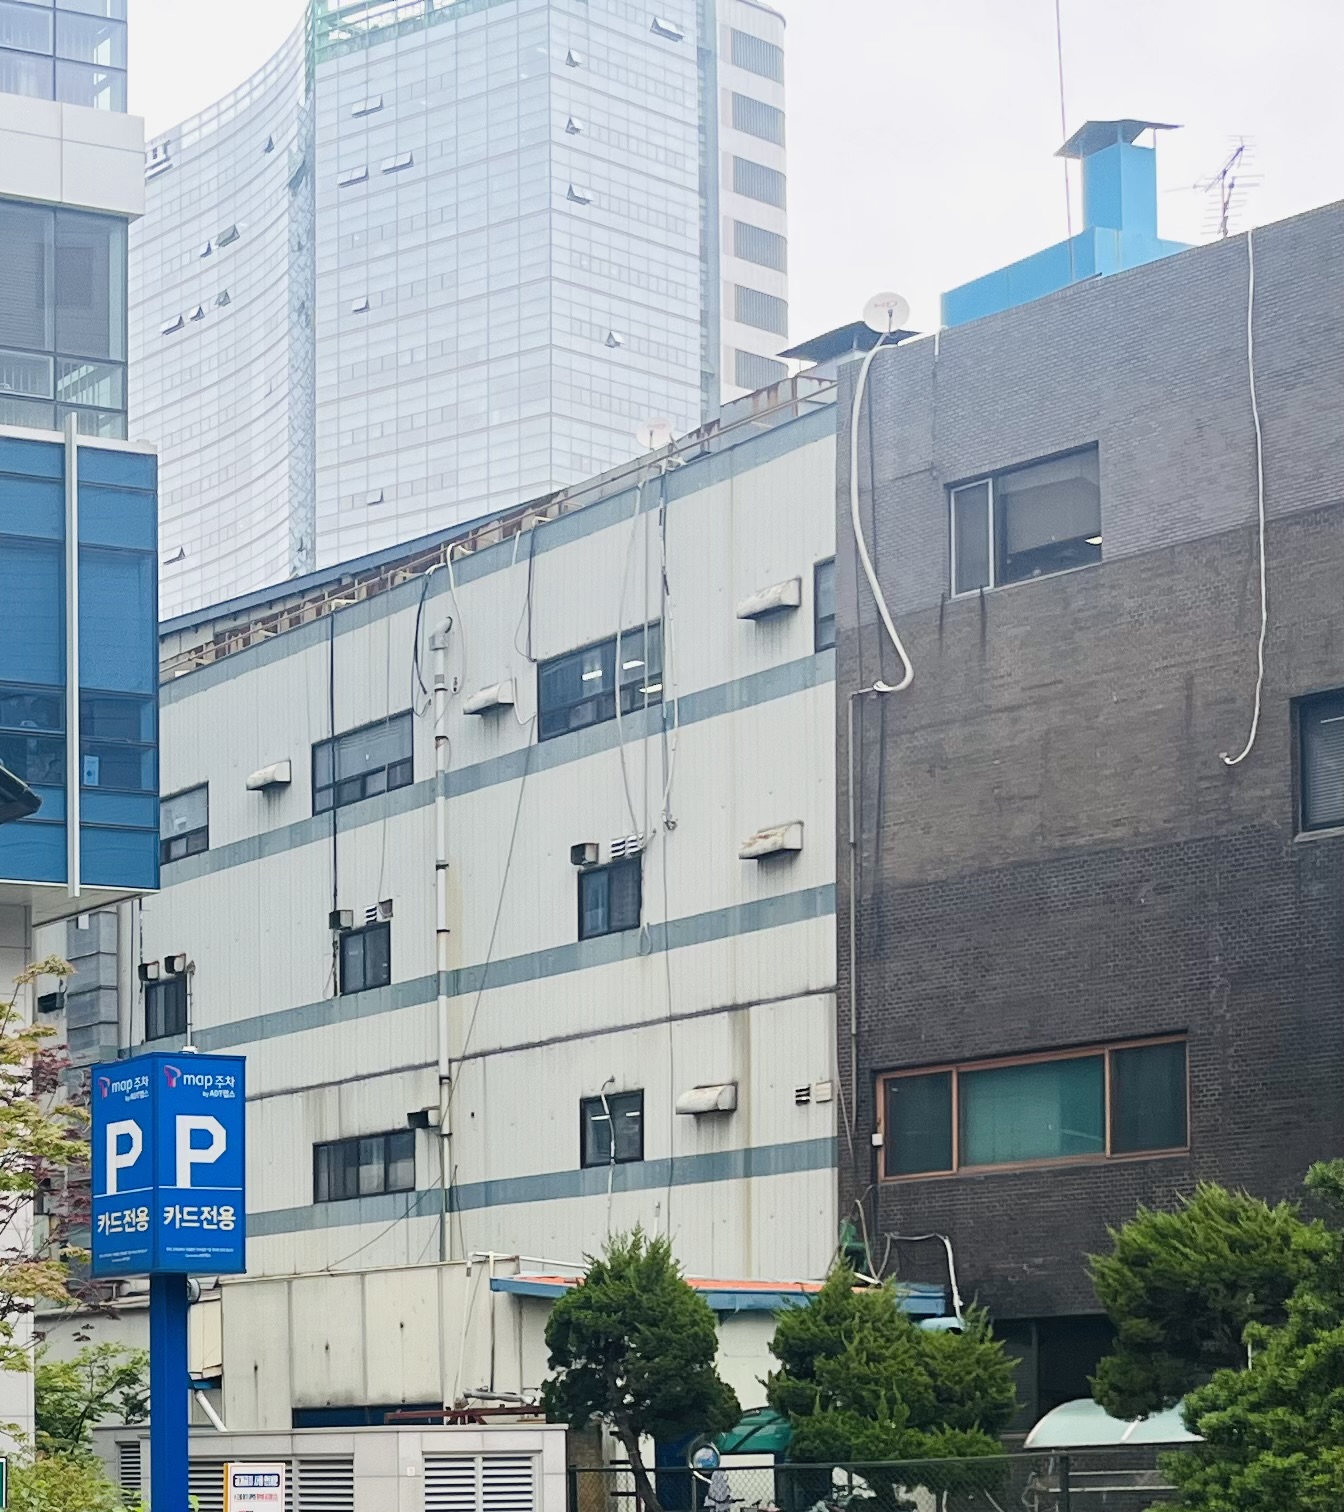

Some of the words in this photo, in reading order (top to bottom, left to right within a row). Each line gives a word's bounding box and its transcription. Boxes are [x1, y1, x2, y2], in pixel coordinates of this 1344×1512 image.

[134, 1075, 149, 1090] 주차
[183, 1074, 213, 1089] map
[215, 1075, 235, 1088] 주차
[106, 1119, 142, 1195] P
[176, 1114, 226, 1188] P
[97, 1206, 150, 1236] 카드전용
[163, 1205, 236, 1231] 카드전용
